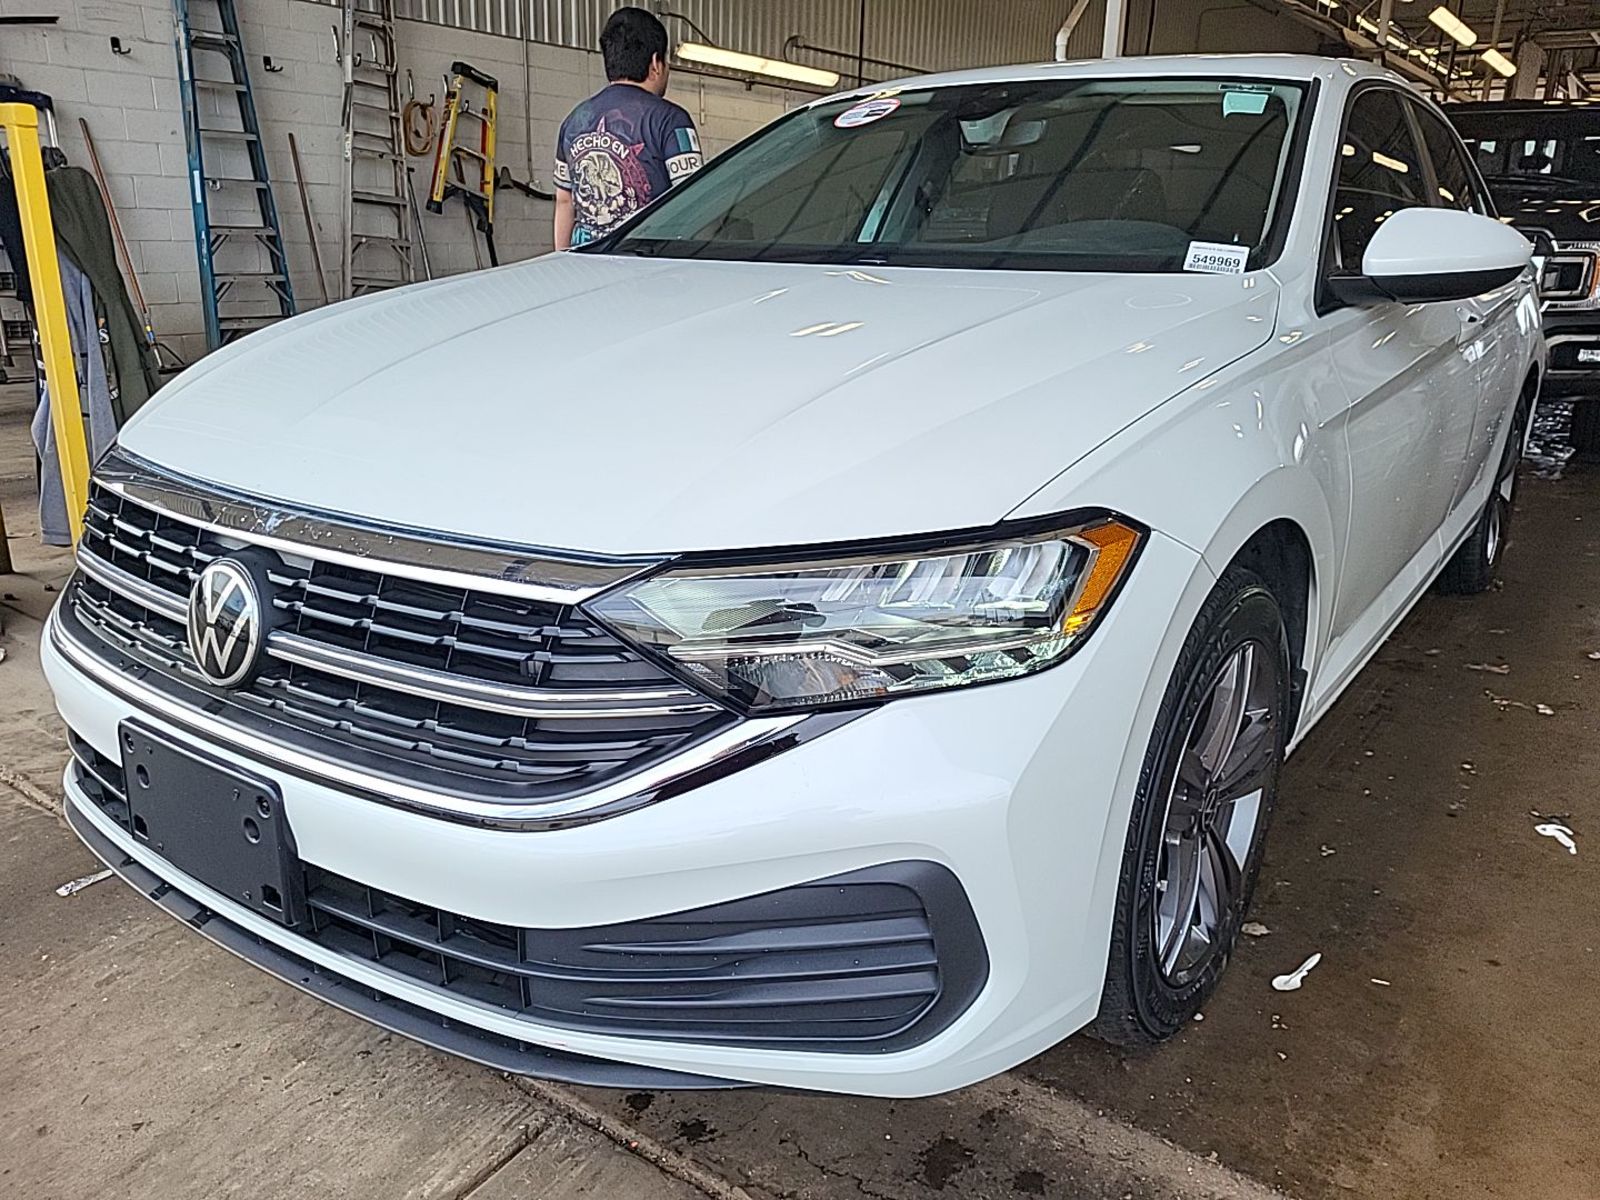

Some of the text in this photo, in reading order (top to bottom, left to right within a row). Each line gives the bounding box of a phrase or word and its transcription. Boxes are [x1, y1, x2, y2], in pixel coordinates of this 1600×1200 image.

[570, 136, 630, 159] HECHO EN
[1192, 254, 1240, 268] 549969
